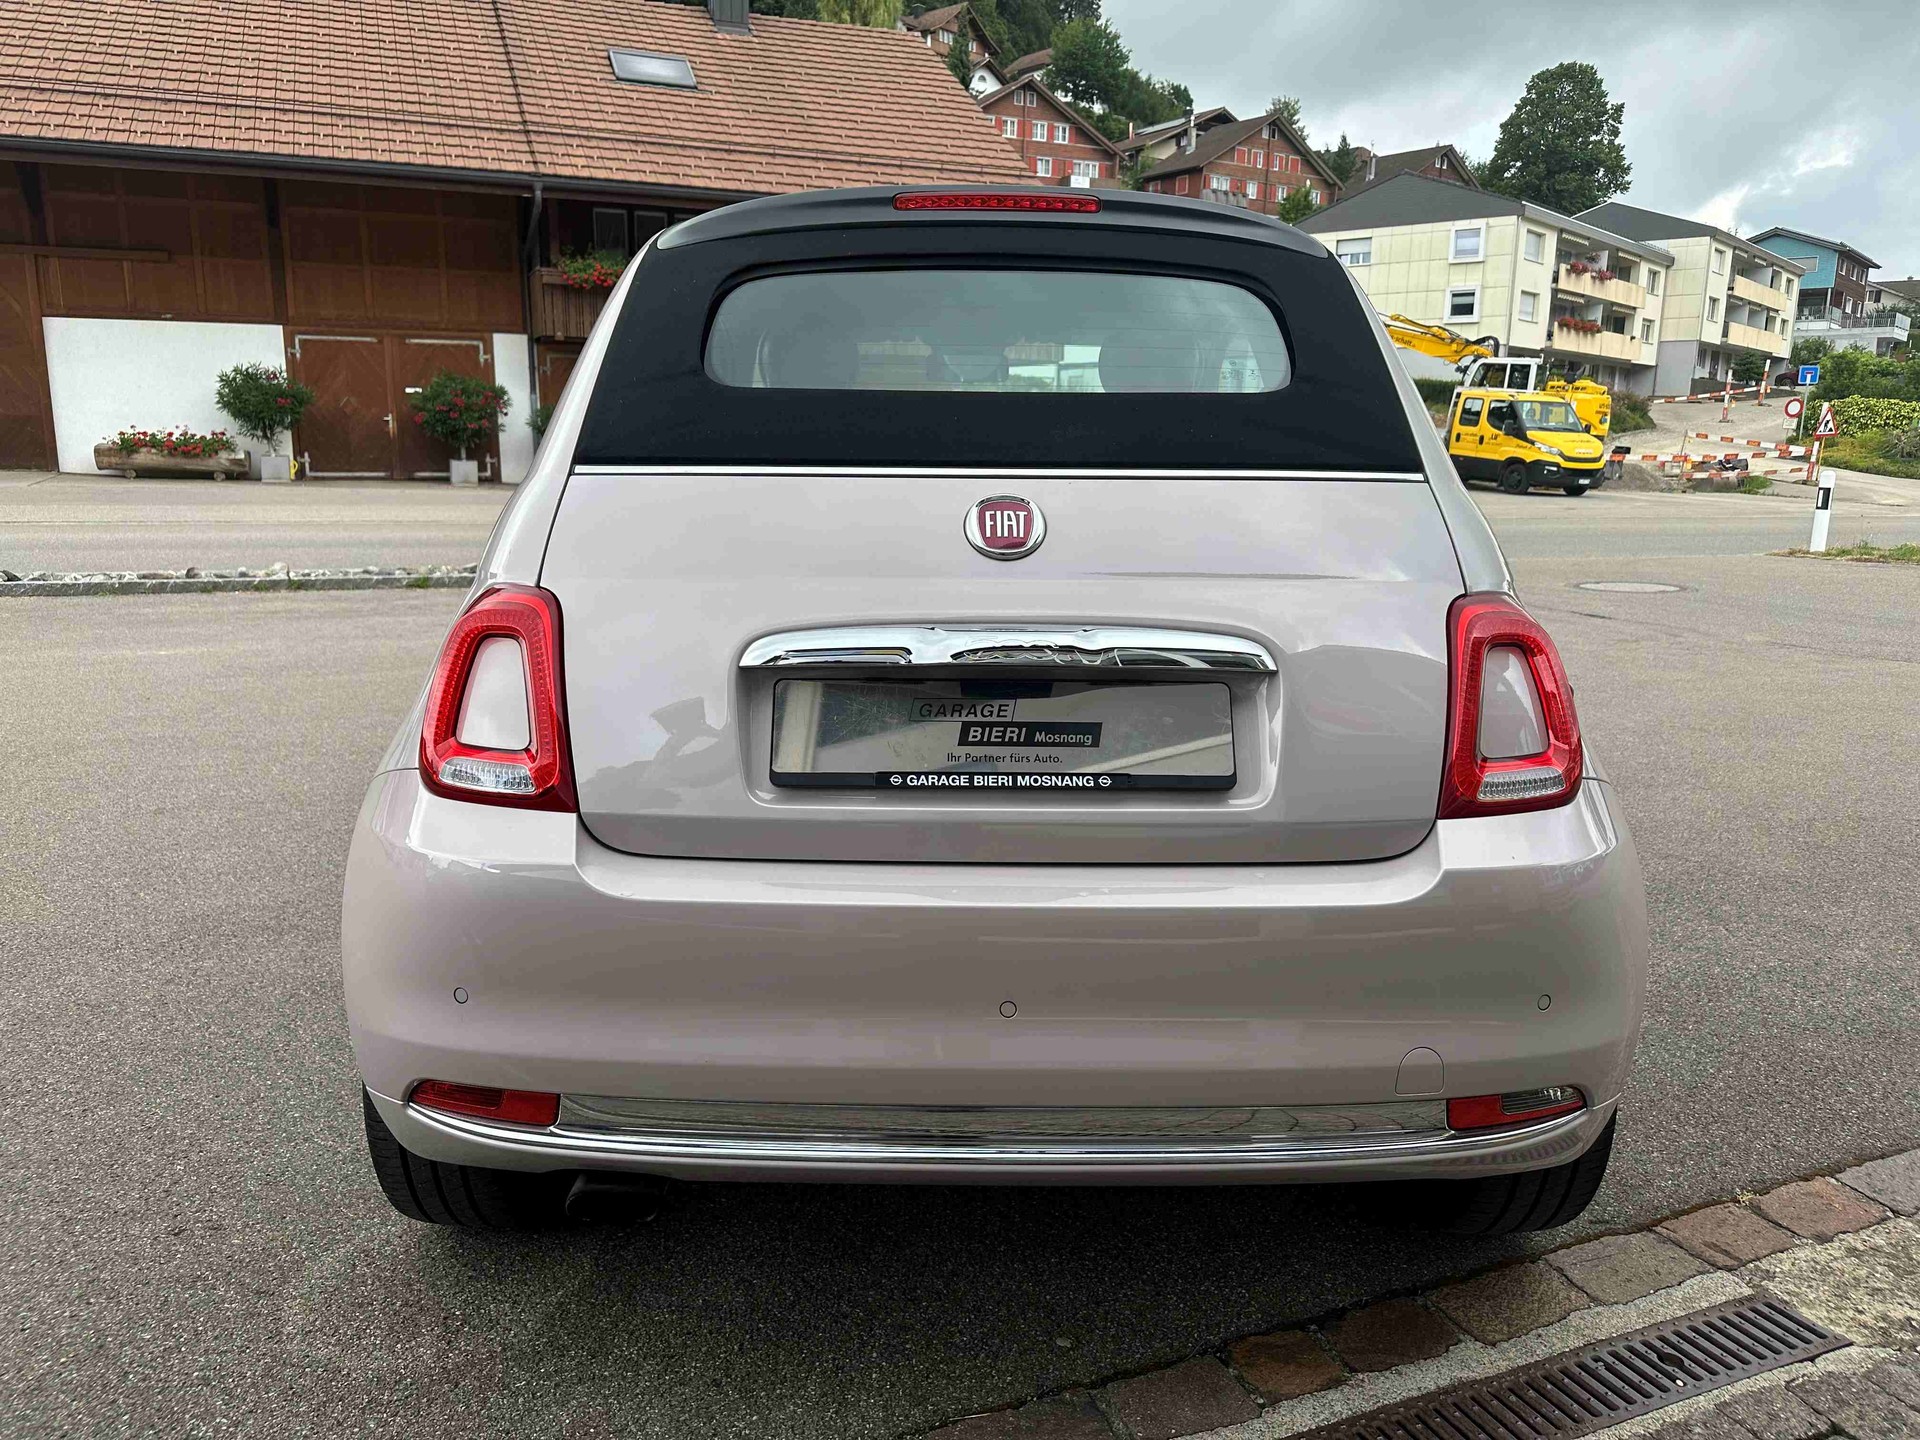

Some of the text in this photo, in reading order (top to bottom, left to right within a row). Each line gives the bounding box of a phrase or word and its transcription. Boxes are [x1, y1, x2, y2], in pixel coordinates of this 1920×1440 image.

[985, 510, 1028, 538] FIAT
[919, 703, 1010, 718] GARAGE
[968, 727, 1093, 745] BIERI Mosnang
[947, 752, 1063, 764] Ihr Partner fürs Auto.
[906, 774, 1095, 787] GARAGE BIERI MOSNANG
